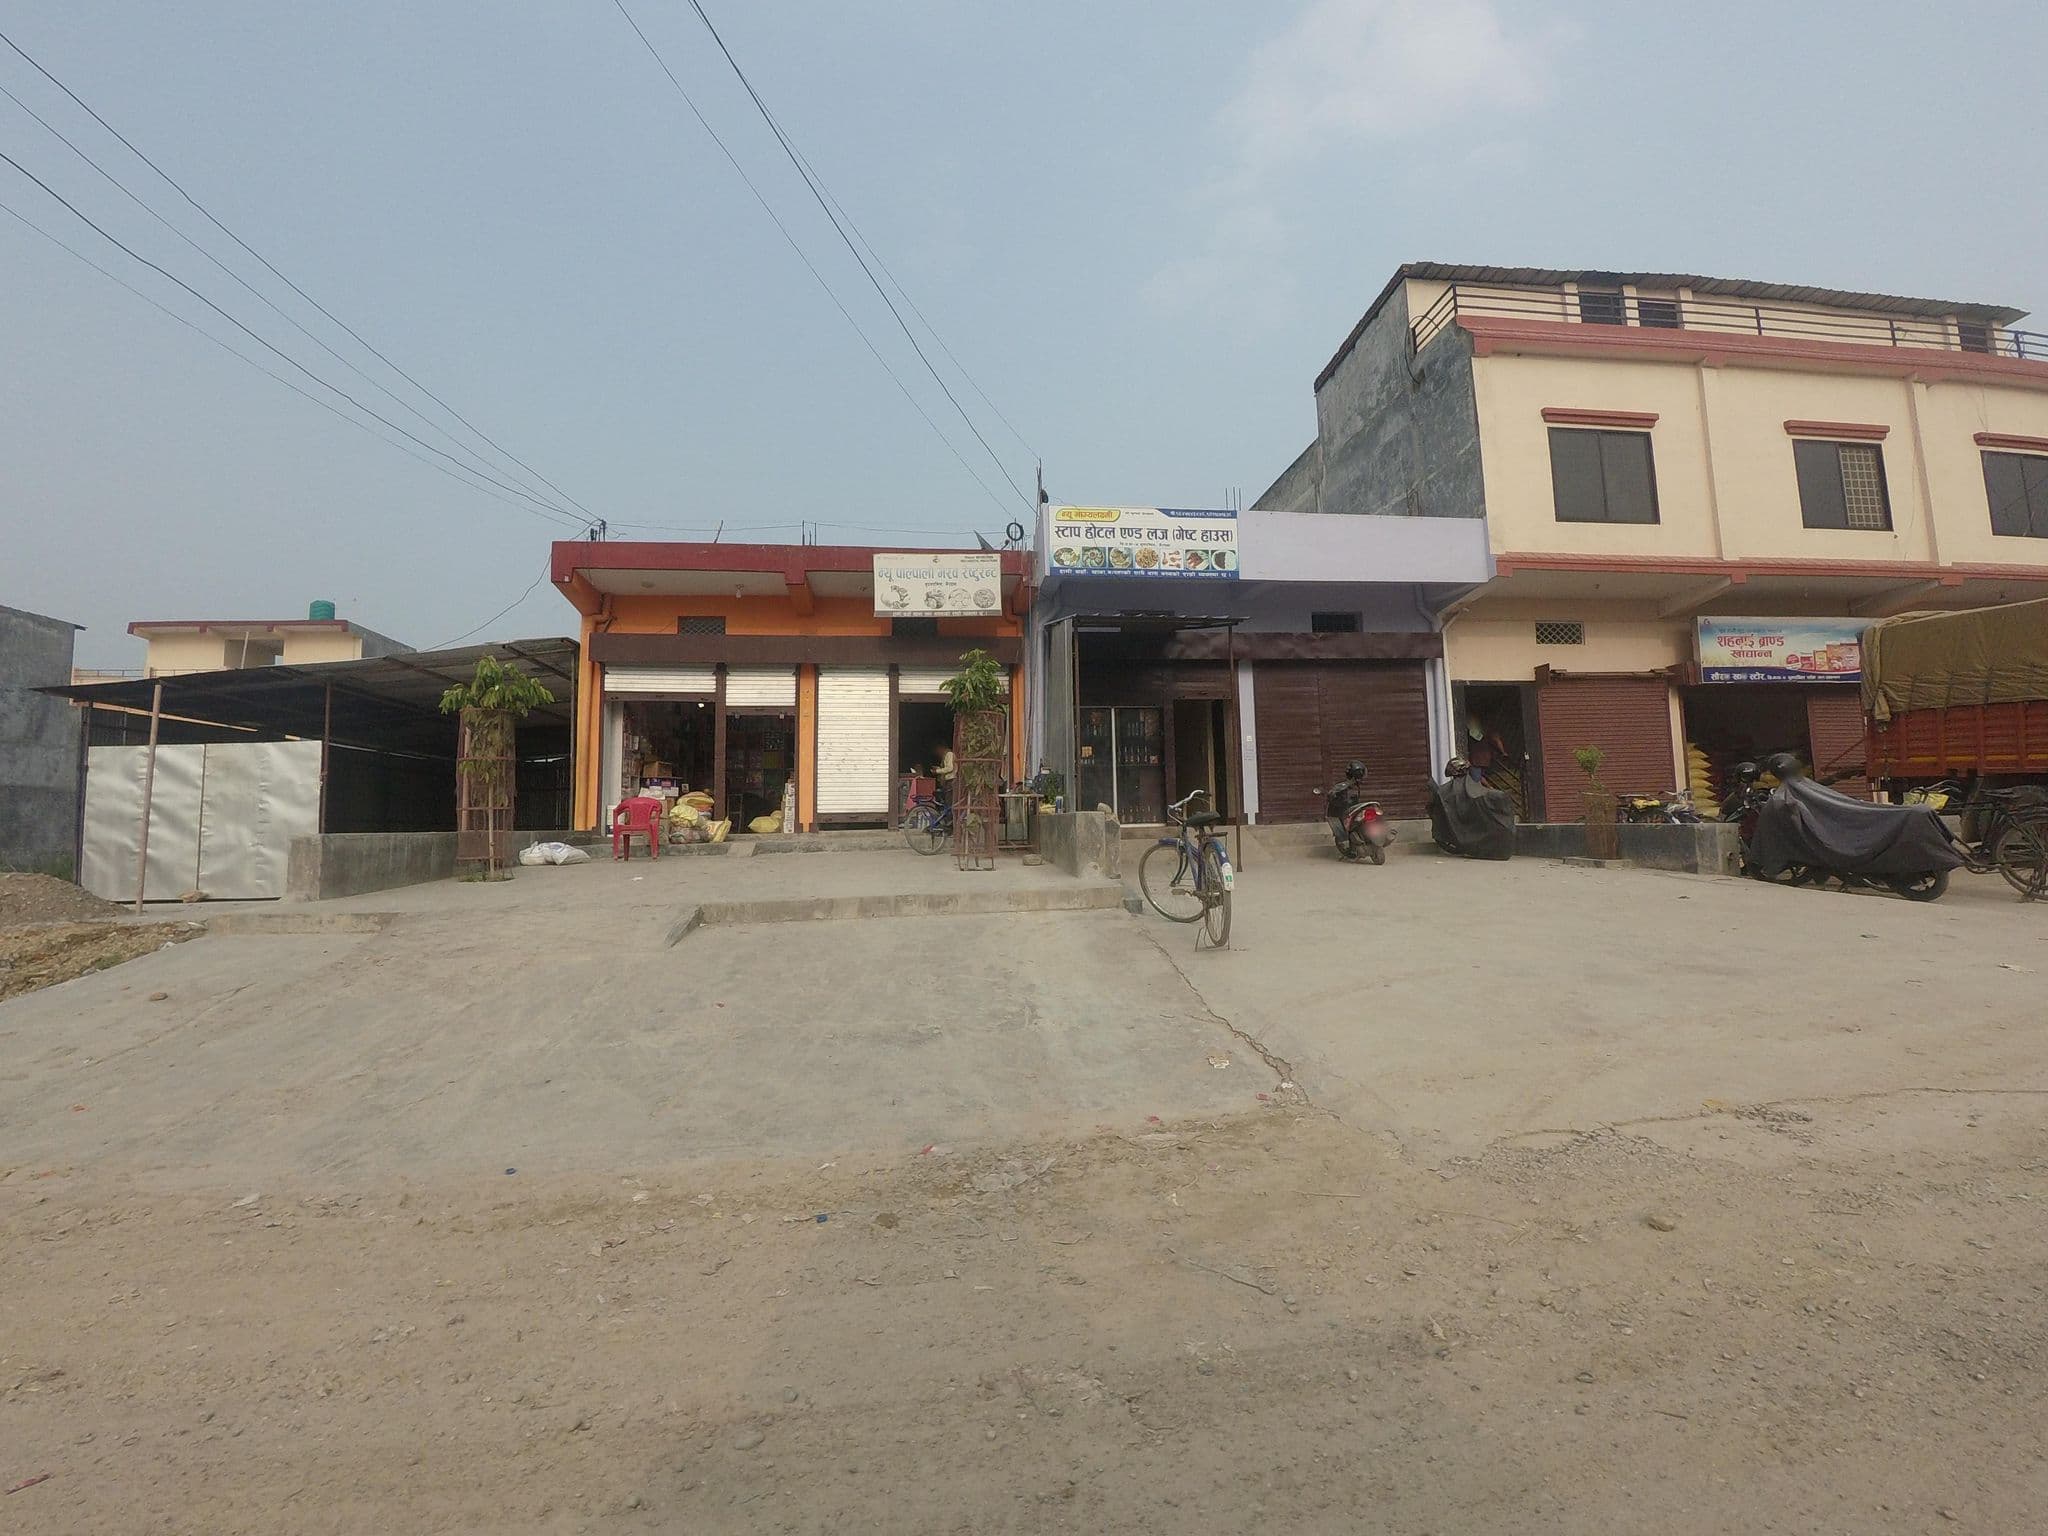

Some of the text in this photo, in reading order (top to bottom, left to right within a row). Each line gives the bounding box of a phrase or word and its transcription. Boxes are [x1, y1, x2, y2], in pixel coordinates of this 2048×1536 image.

[1054, 525, 1082, 539] स्टाप
[1085, 522, 1116, 539] होटल
[1119, 527, 1143, 540] एण्ड
[1146, 527, 1169, 541] लज
[1200, 529, 1233, 542] हाउस)
